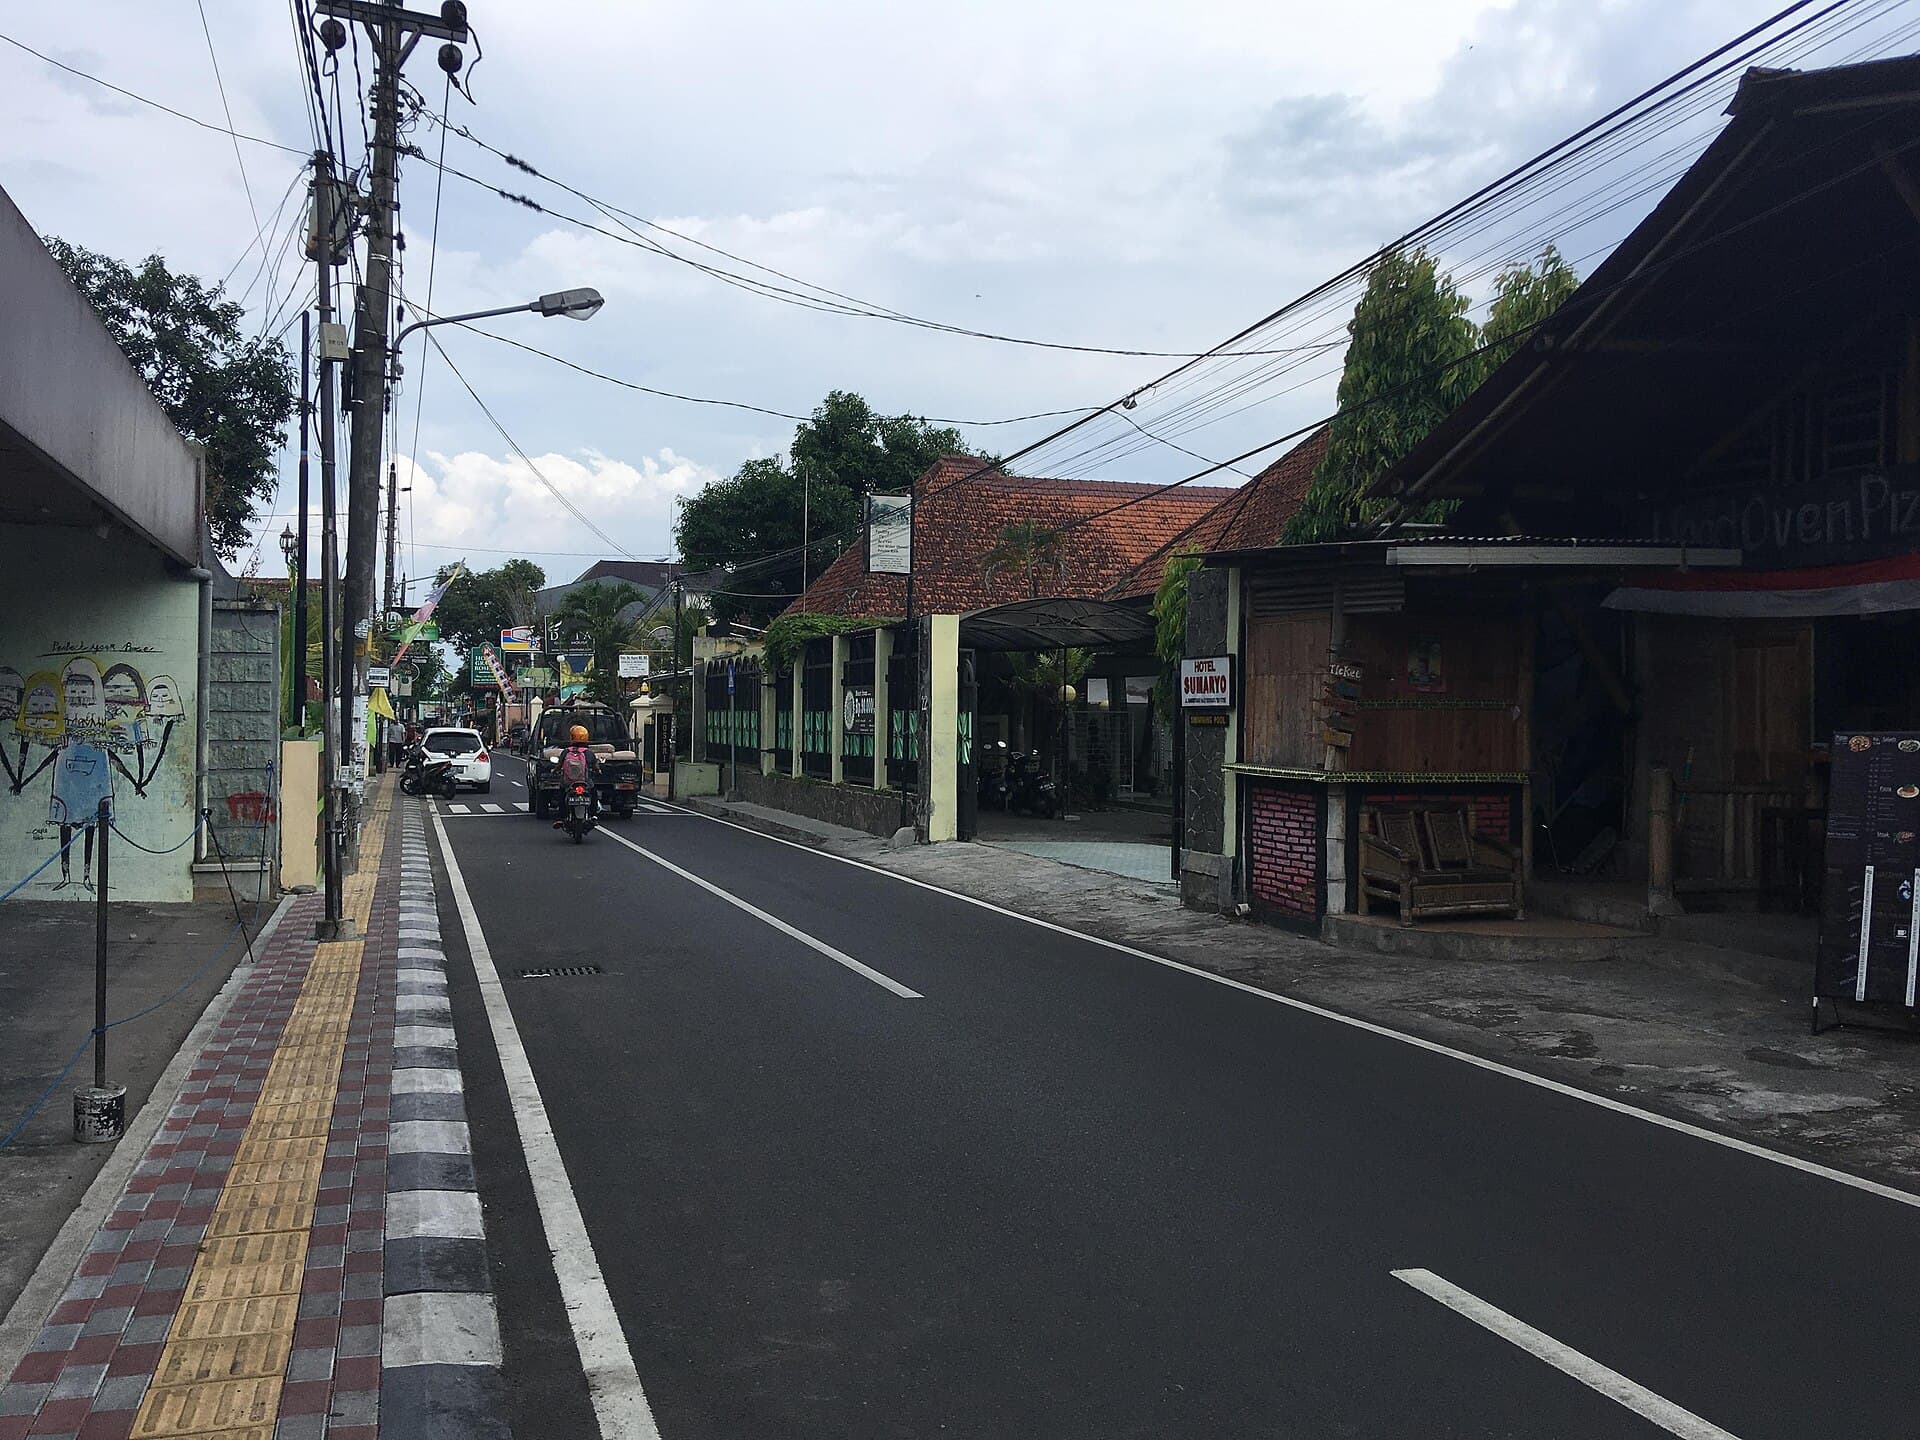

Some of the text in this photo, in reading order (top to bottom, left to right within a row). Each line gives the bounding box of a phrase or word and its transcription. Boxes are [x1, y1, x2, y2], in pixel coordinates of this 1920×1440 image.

[1741, 496, 1856, 547] Oven
[1194, 660, 1216, 673] HOTEL
[1183, 675, 1227, 695] SUMARYO
